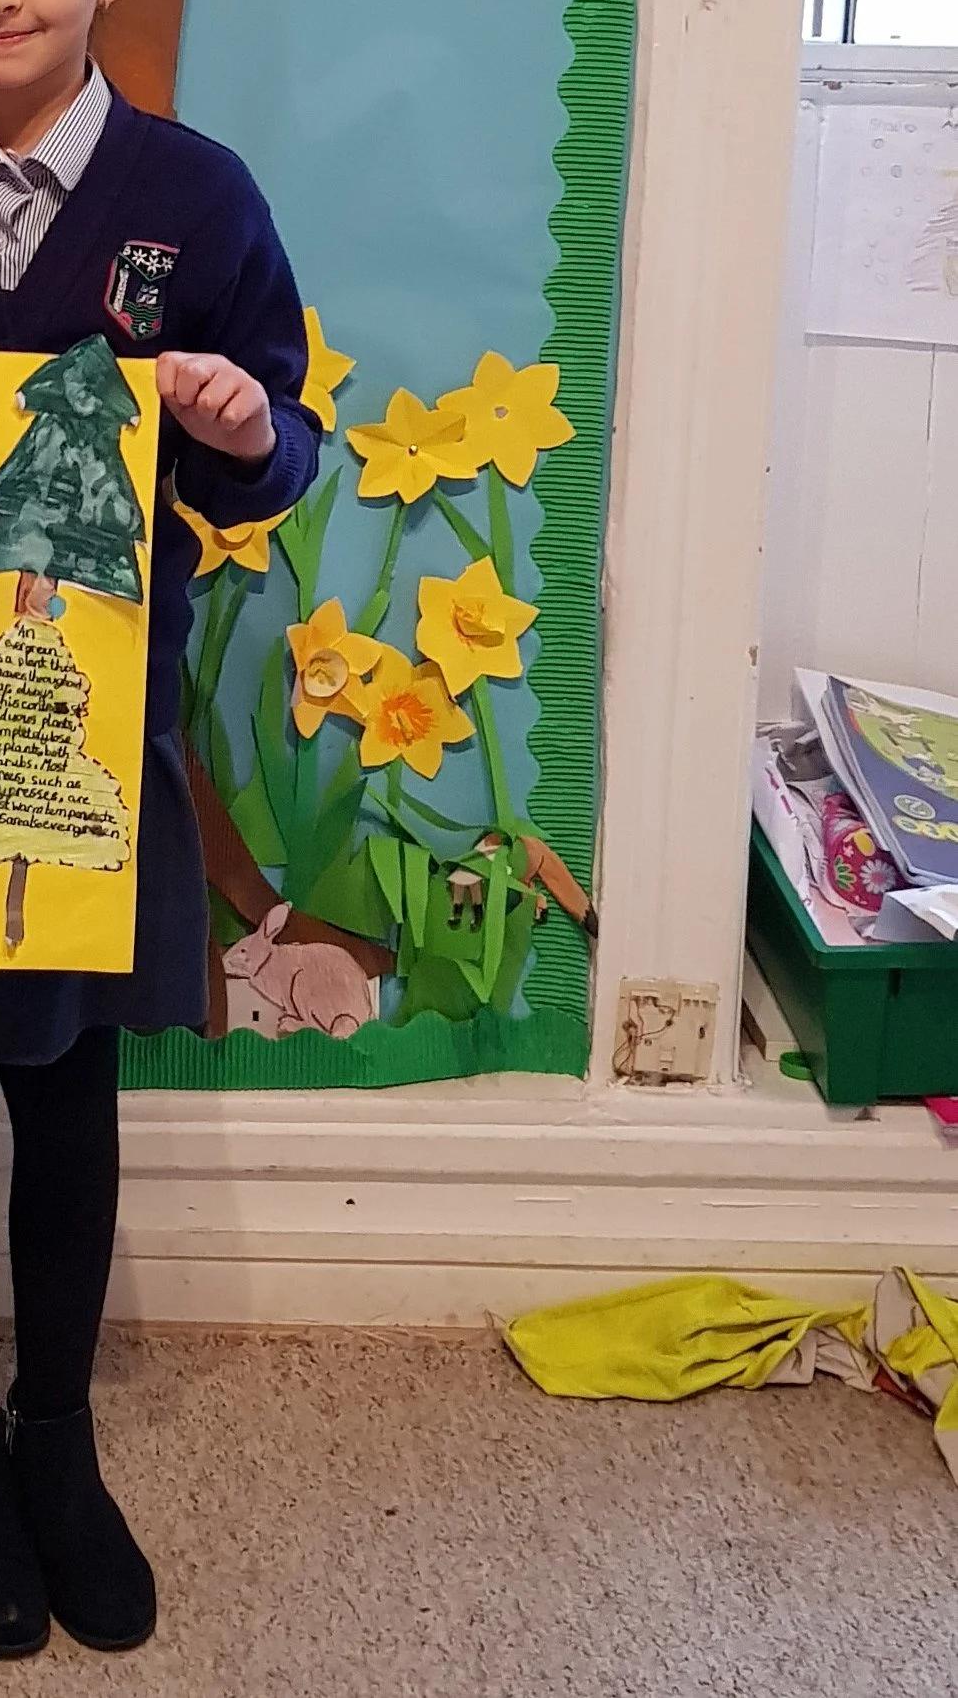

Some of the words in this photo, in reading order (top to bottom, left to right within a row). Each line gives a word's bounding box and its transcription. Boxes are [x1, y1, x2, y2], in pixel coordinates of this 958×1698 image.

[18, 624, 35, 639] An
[41, 758, 69, 773] Most
[32, 771, 62, 788] such
[66, 779, 82, 790] as
[68, 793, 91, 806] are
